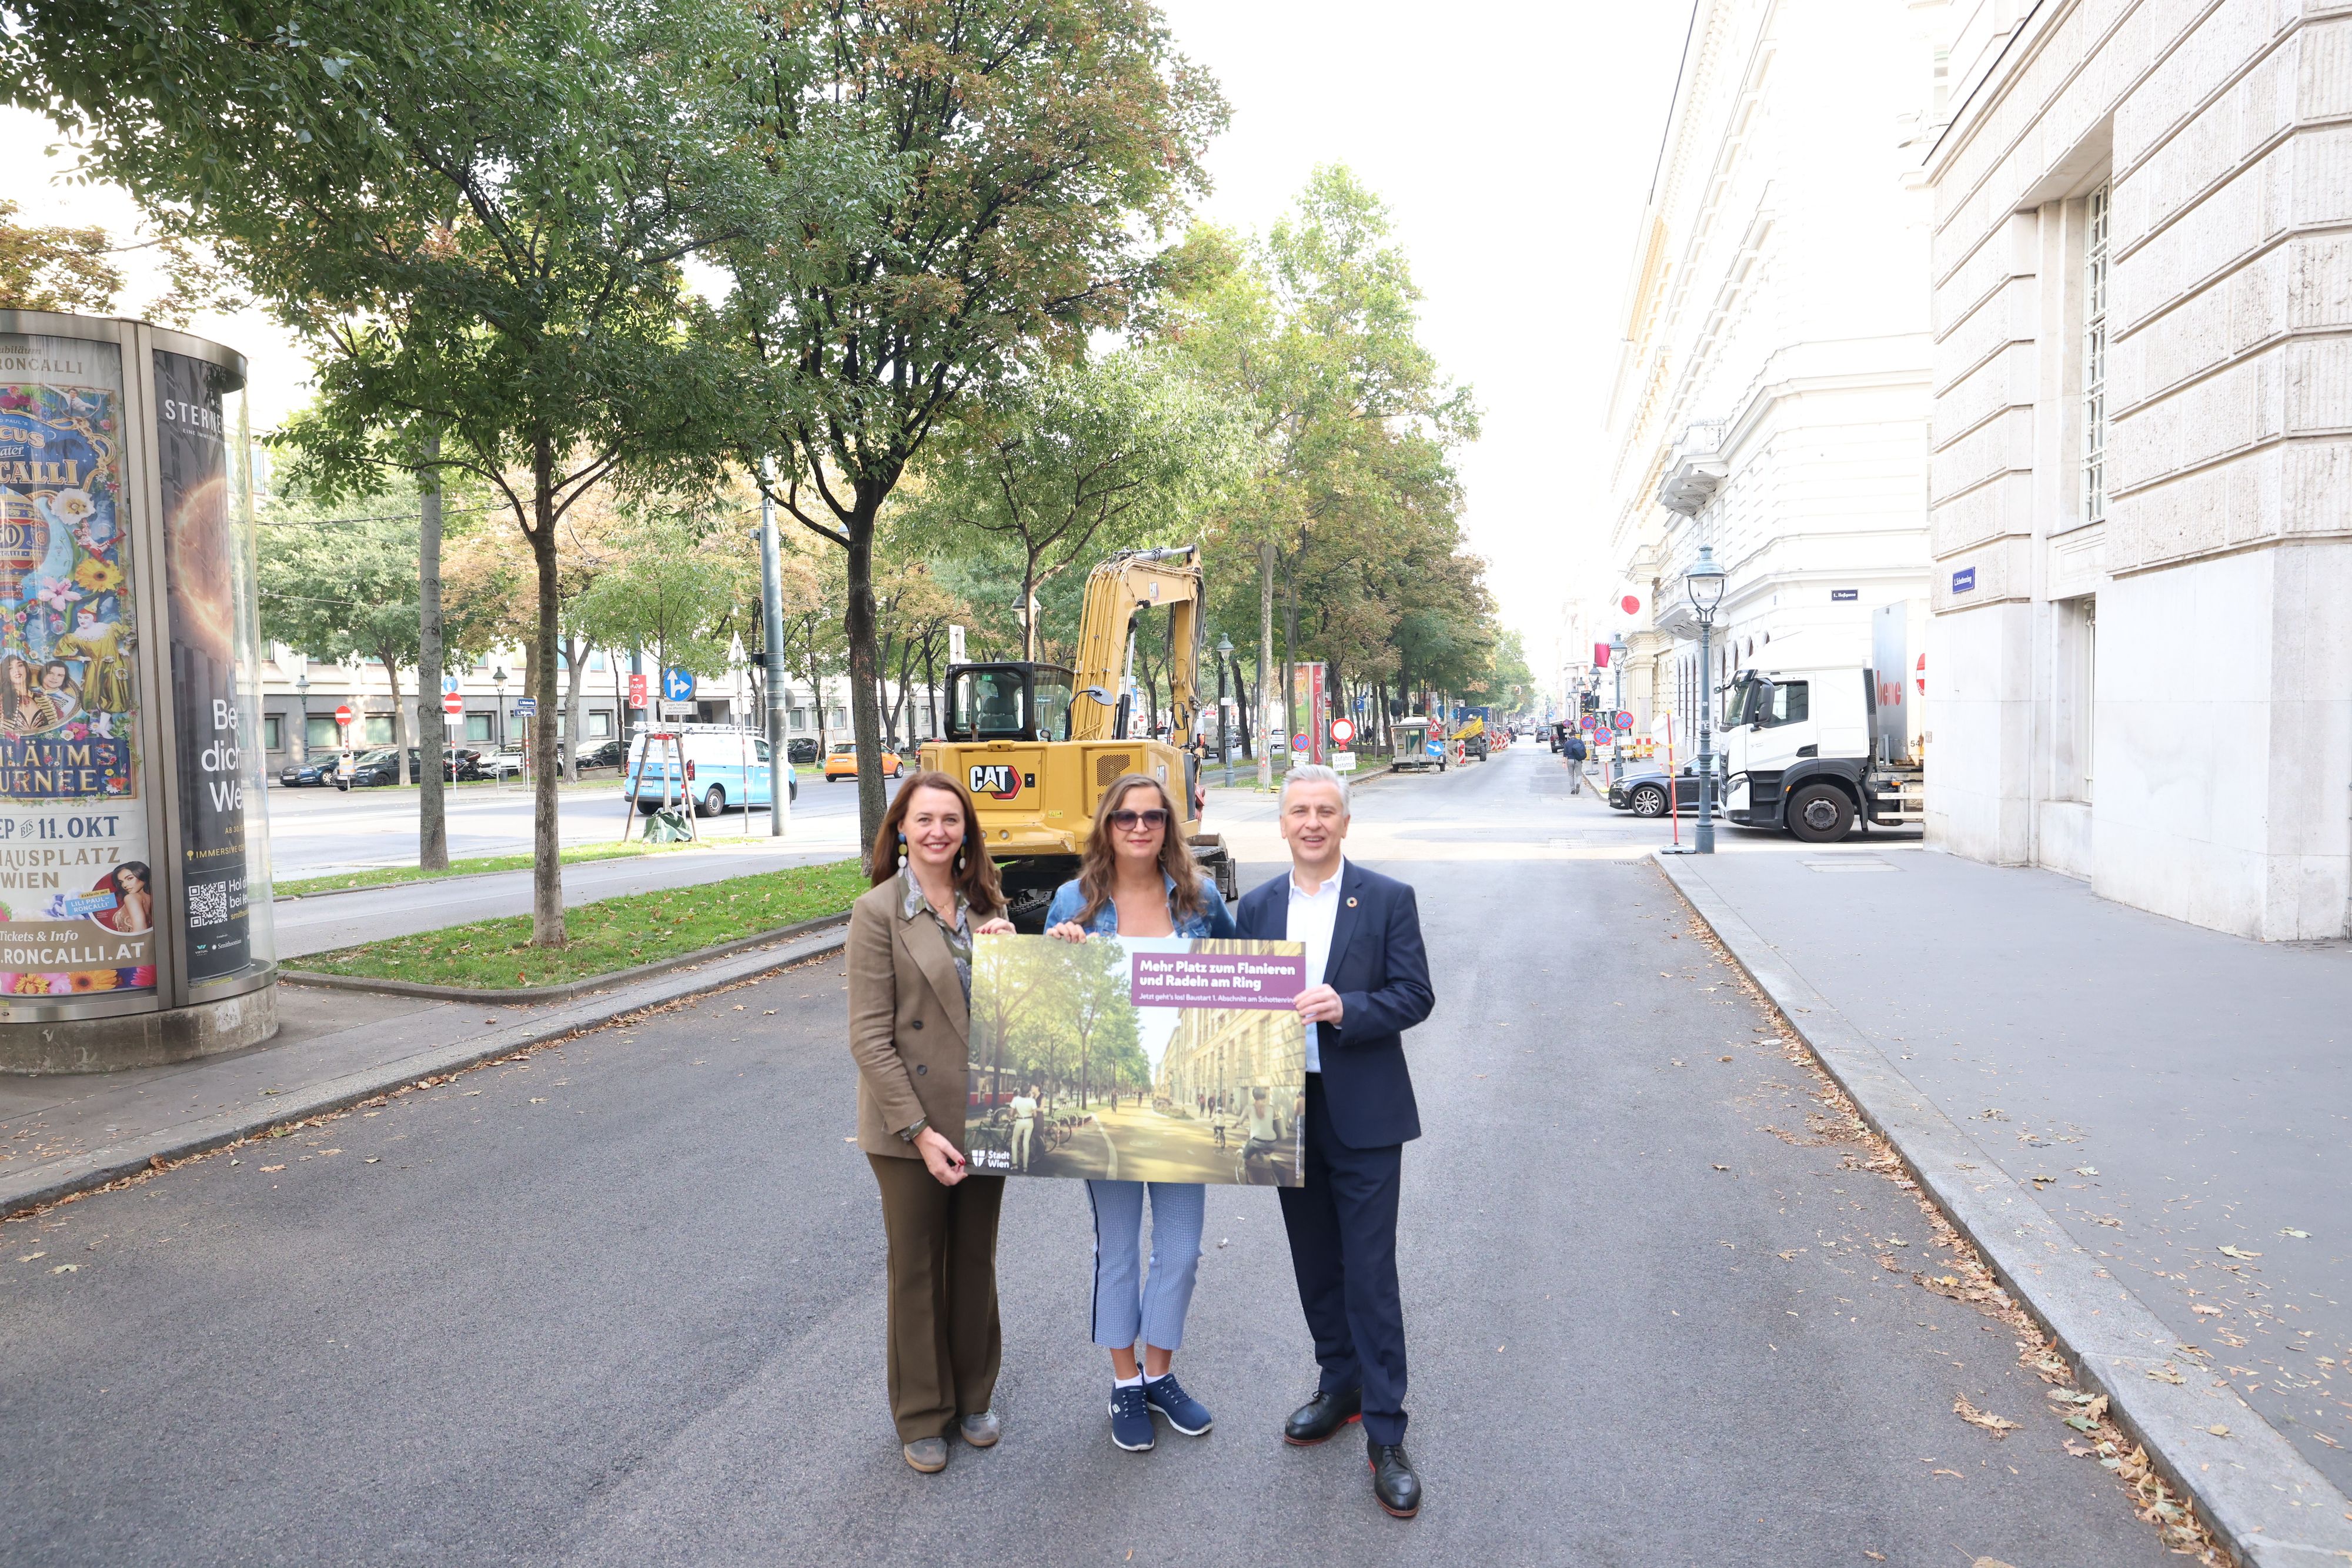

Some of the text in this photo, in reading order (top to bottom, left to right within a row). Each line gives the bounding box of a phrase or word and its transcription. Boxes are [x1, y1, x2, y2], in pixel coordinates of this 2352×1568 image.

[0, 357, 82, 375] ONCALLI
[1149, 582, 1157, 599] CAT
[970, 766, 1008, 791] CAT
[21, 820, 34, 837] BIS
[0, 847, 120, 871] AUSPLATZ
[196, 845, 238, 858] IMMERSIVE
[1, 872, 59, 888] WIEN
[229, 877, 242, 892] Hol
[229, 893, 242, 908] bei
[36, 931, 46, 942] &
[50, 930, 79, 943] Info
[218, 939, 242, 950] Smithsonian
[1140, 960, 1296, 975] Mehr Platz zum Flanieren
[1140, 974, 1262, 991] und Radeln am Ring
[1155, 994, 1174, 1002] geht's
[988, 1150, 1010, 1159] Stadt
[988, 1159, 1010, 1168] Wien
